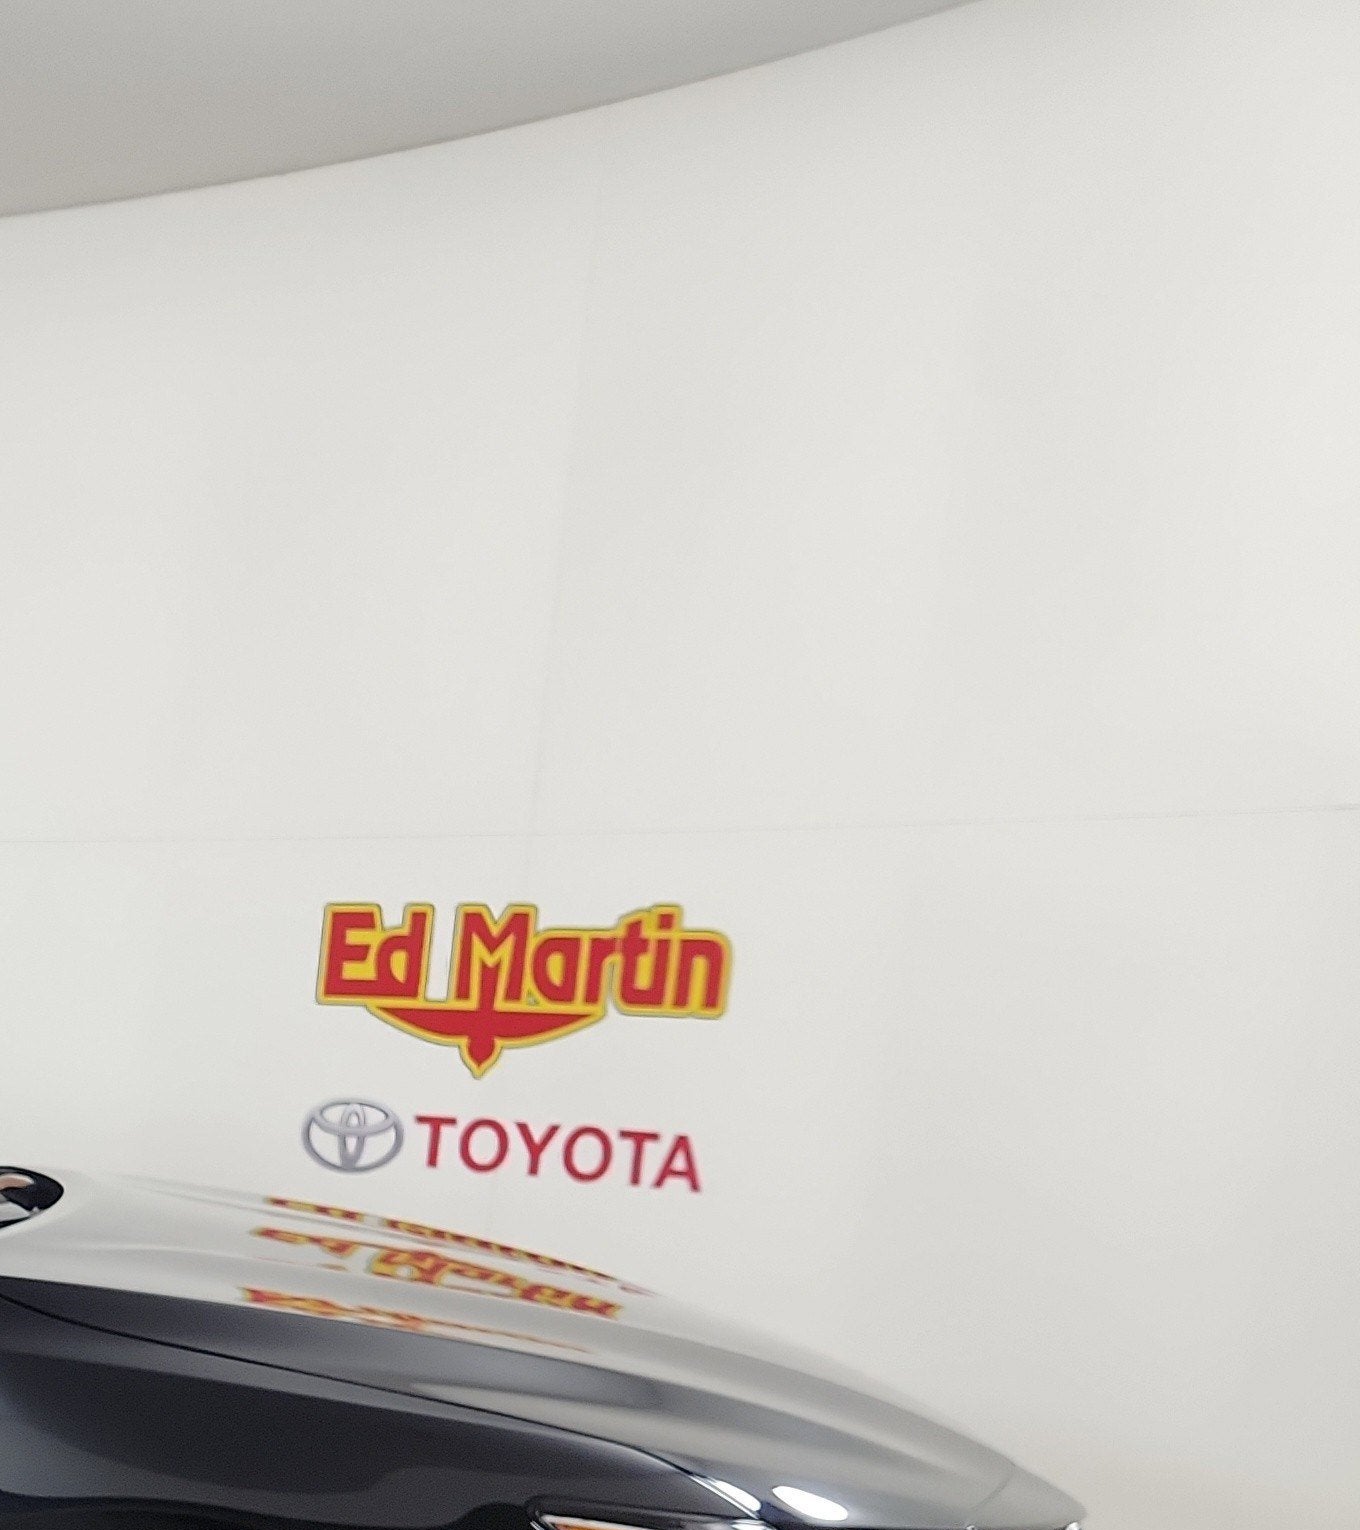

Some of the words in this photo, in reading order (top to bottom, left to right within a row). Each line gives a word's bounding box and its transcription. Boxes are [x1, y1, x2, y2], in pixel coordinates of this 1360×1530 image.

[316, 902, 434, 1005] Ed
[450, 902, 734, 1020] Martin
[414, 1113, 703, 1193] TOYOTA
